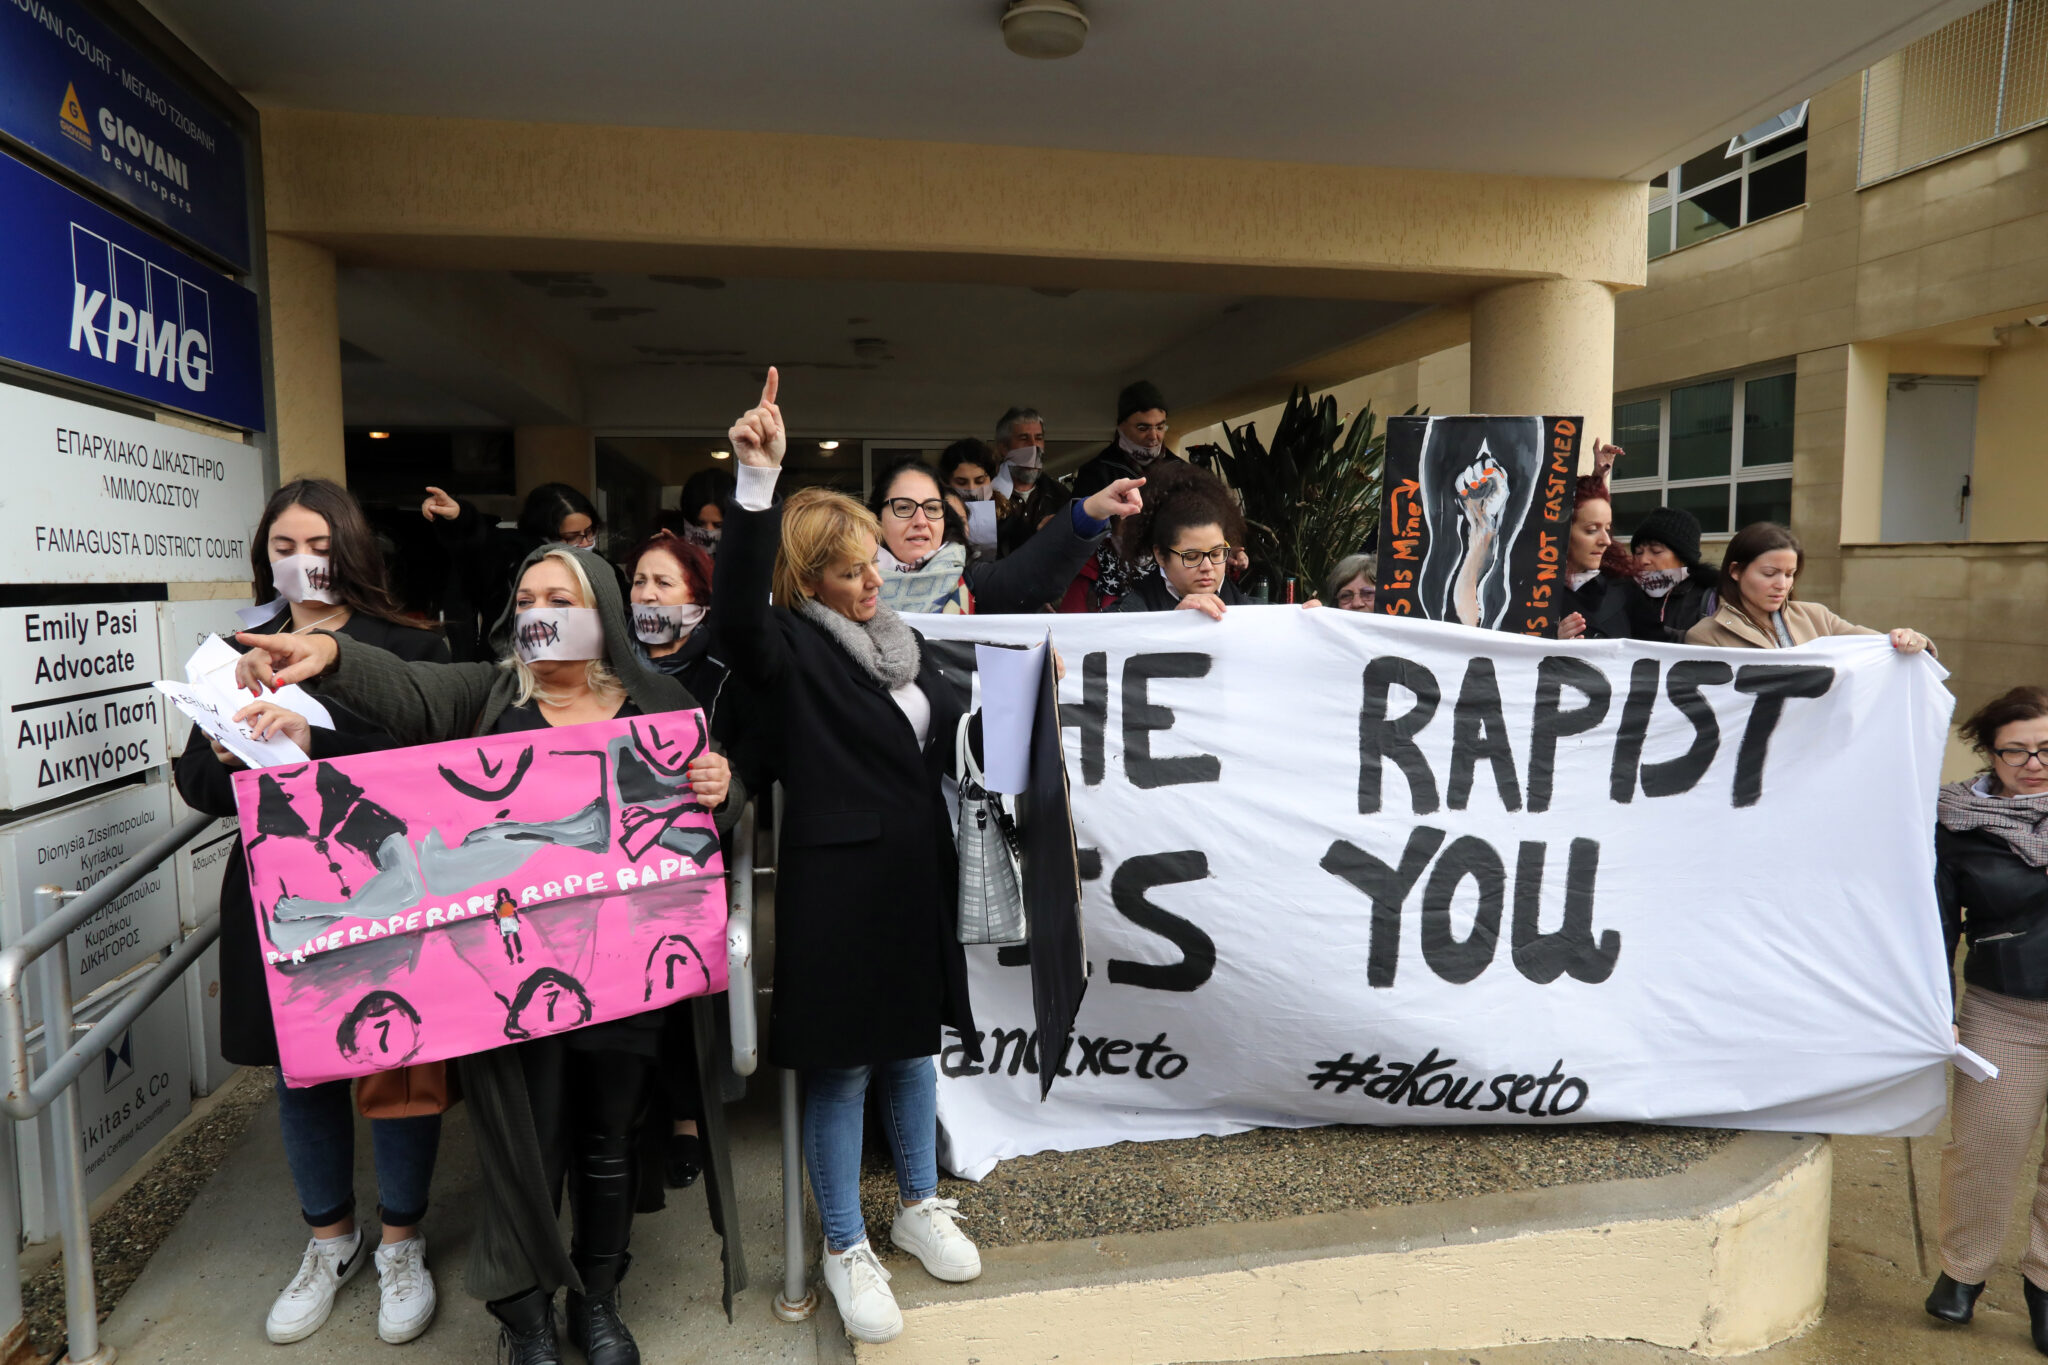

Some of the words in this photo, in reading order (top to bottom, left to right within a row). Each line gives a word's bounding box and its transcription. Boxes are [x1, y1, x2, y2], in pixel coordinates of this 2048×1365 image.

[11, 0, 63, 39] OVANI
[66, 27, 112, 74] COURT
[60, 119, 93, 147] GIOVANI
[69, 101, 79, 119] G
[98, 107, 189, 191] GIOVANI
[101, 144, 192, 213] Developers
[69, 282, 207, 392] KPMG
[56, 427, 148, 468] ΕΠΑΡΧΙΑΚΟ
[152, 449, 225, 481] ΔΙΚΑΣΤΗΡΙΟ
[35, 526, 141, 555] FAMAGUSTA
[145, 534, 202, 557] DISTRICT
[205, 538, 244, 559] COURT
[1392, 502, 1422, 561] Mine
[1537, 531, 1559, 582] NOT
[25, 612, 89, 645] Emily
[96, 609, 137, 636] Pasi
[35, 649, 135, 684] Advocate
[17, 708, 98, 750] Αιμιλία
[104, 695, 157, 728] Πασή
[1357, 655, 1835, 815] RAPIST
[38, 739, 150, 788] Δικηγόρος
[37, 835, 85, 865] Dionysia
[87, 810, 155, 845] Zissimopoulou
[80, 843, 124, 872] Kyriakou
[349, 910, 419, 943] RAPE
[425, 893, 496, 928] RAPE
[521, 871, 608, 905] RAPE
[616, 856, 696, 890] RAPE
[1318, 825, 1622, 989] YOU
[80, 928, 140, 976] ΔΙΚΗΓΟΡΟΣ
[85, 915, 131, 949] Κυριάκου
[1307, 1048, 1590, 1118] #akouseto
[82, 1102, 131, 1153] ikitas
[135, 1087, 146, 1110] &
[149, 1072, 169, 1097] Co
